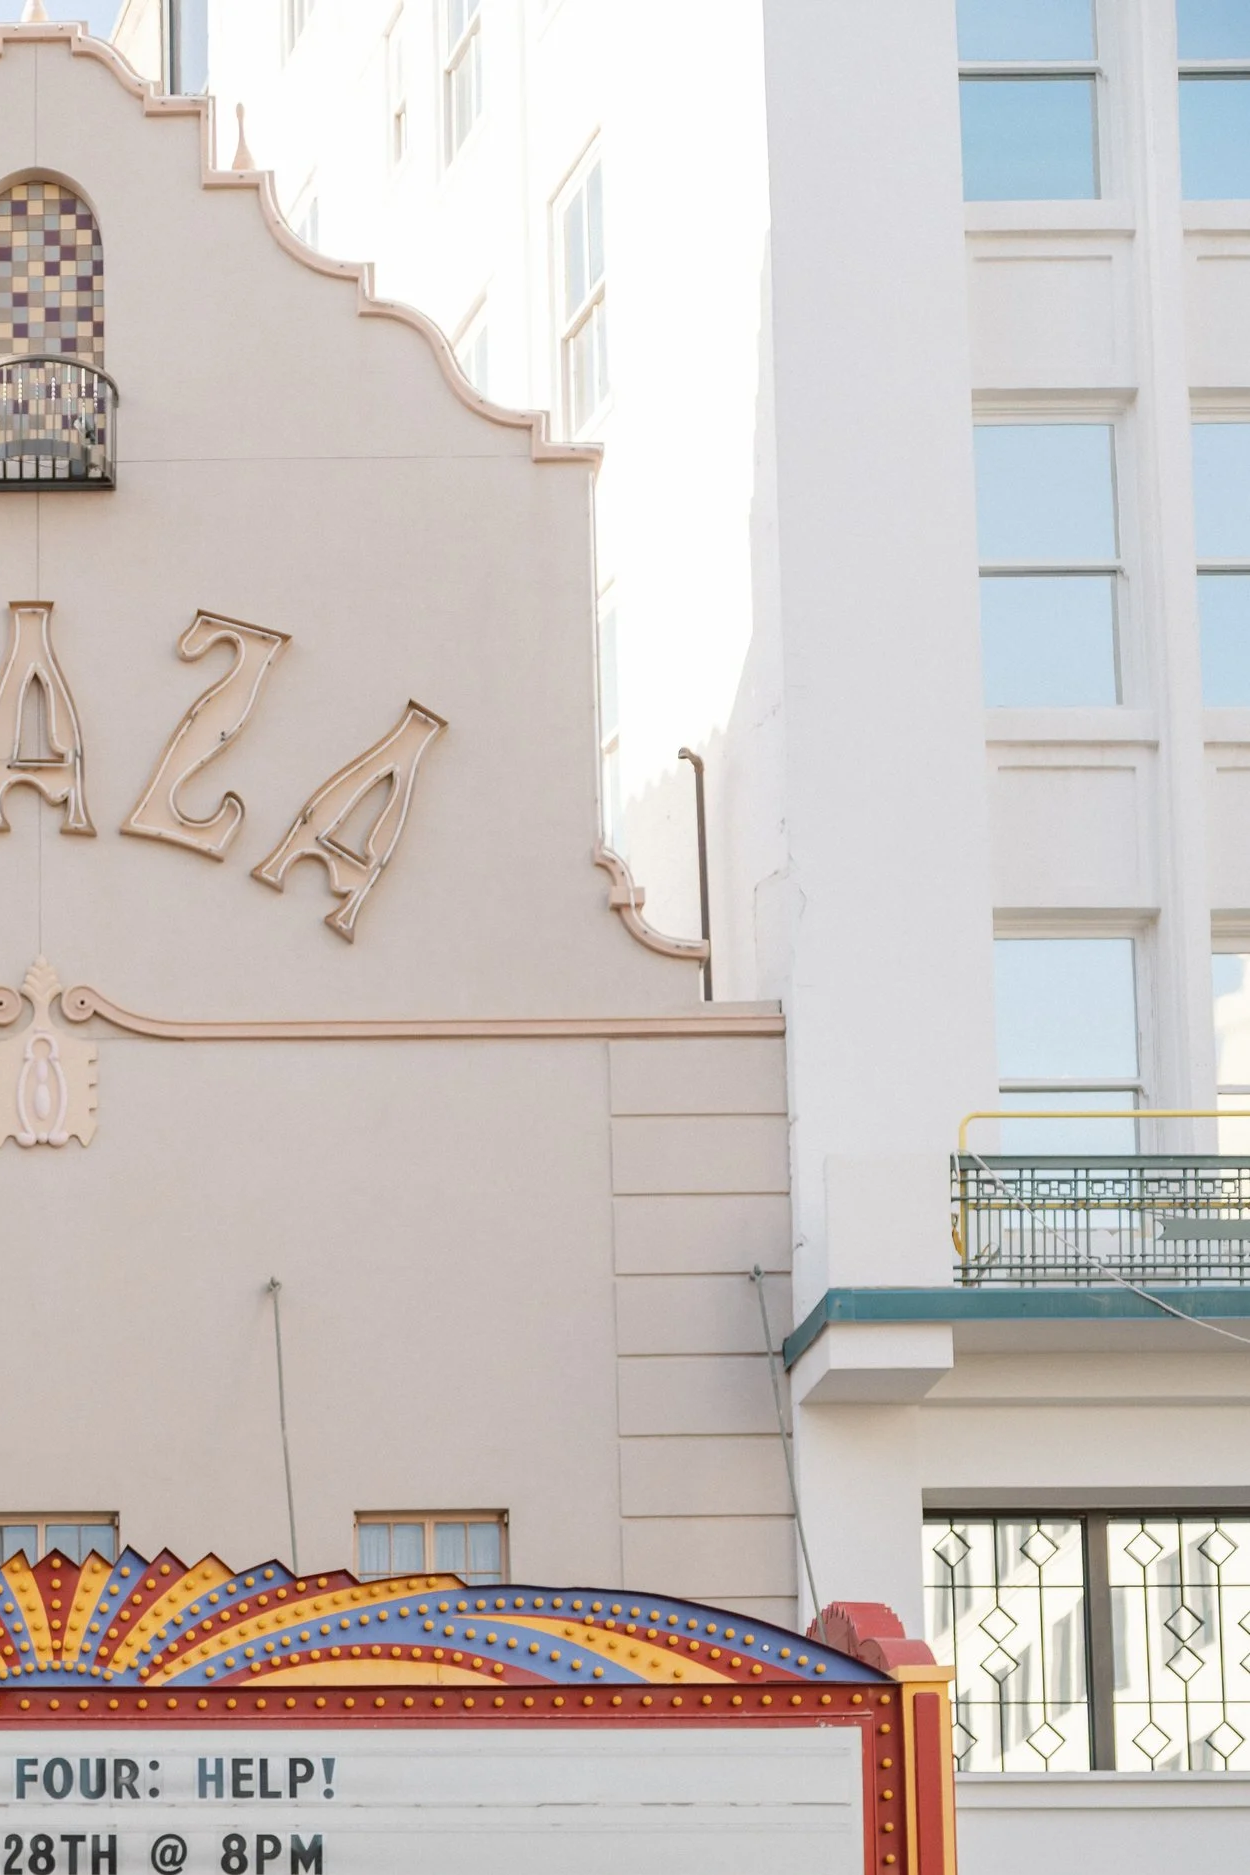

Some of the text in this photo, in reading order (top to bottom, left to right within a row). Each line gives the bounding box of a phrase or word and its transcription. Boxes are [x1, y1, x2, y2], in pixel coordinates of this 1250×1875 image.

[15, 1757, 161, 1800] FOUR:
[197, 1757, 338, 1800] HELP!
[4, 1833, 118, 1875] 28TH
[150, 1833, 188, 1875] @
[221, 1833, 324, 1875] 8PM
